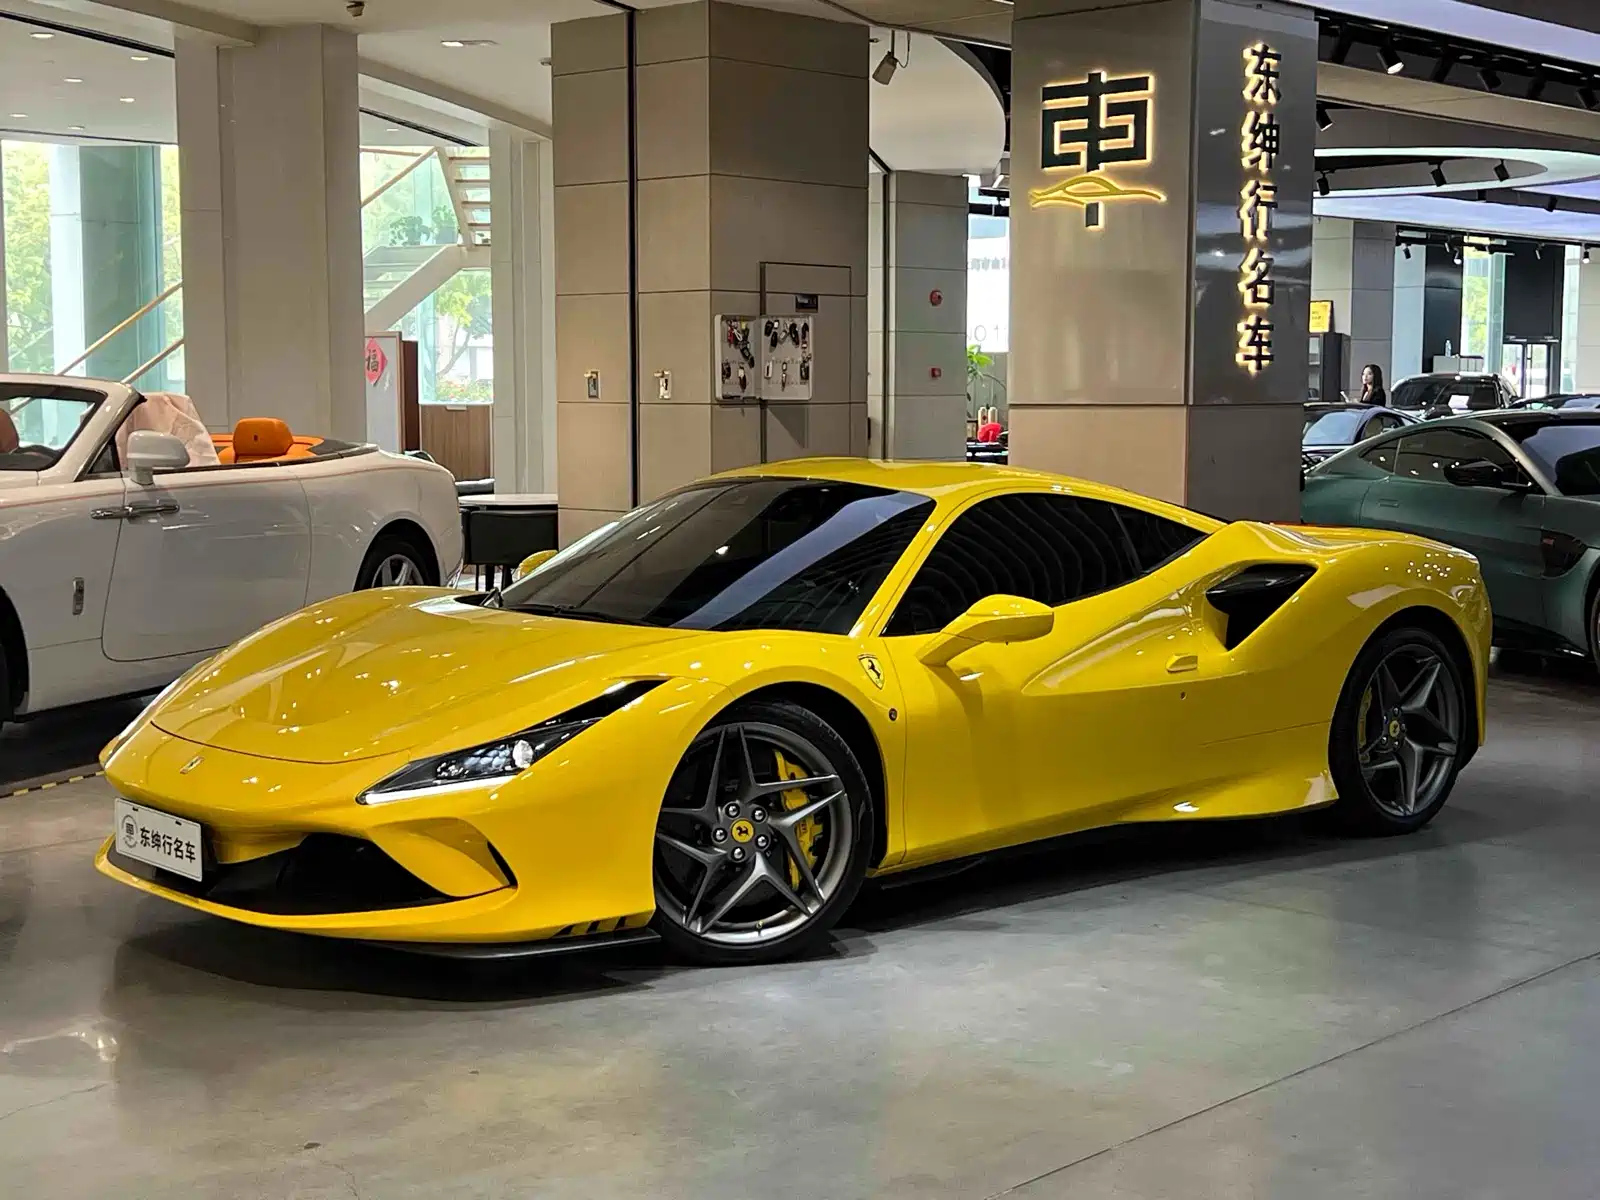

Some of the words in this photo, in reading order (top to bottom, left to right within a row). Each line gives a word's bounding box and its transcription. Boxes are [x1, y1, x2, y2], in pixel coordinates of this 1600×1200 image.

[1237, 43, 1281, 375] 东绅行名车
